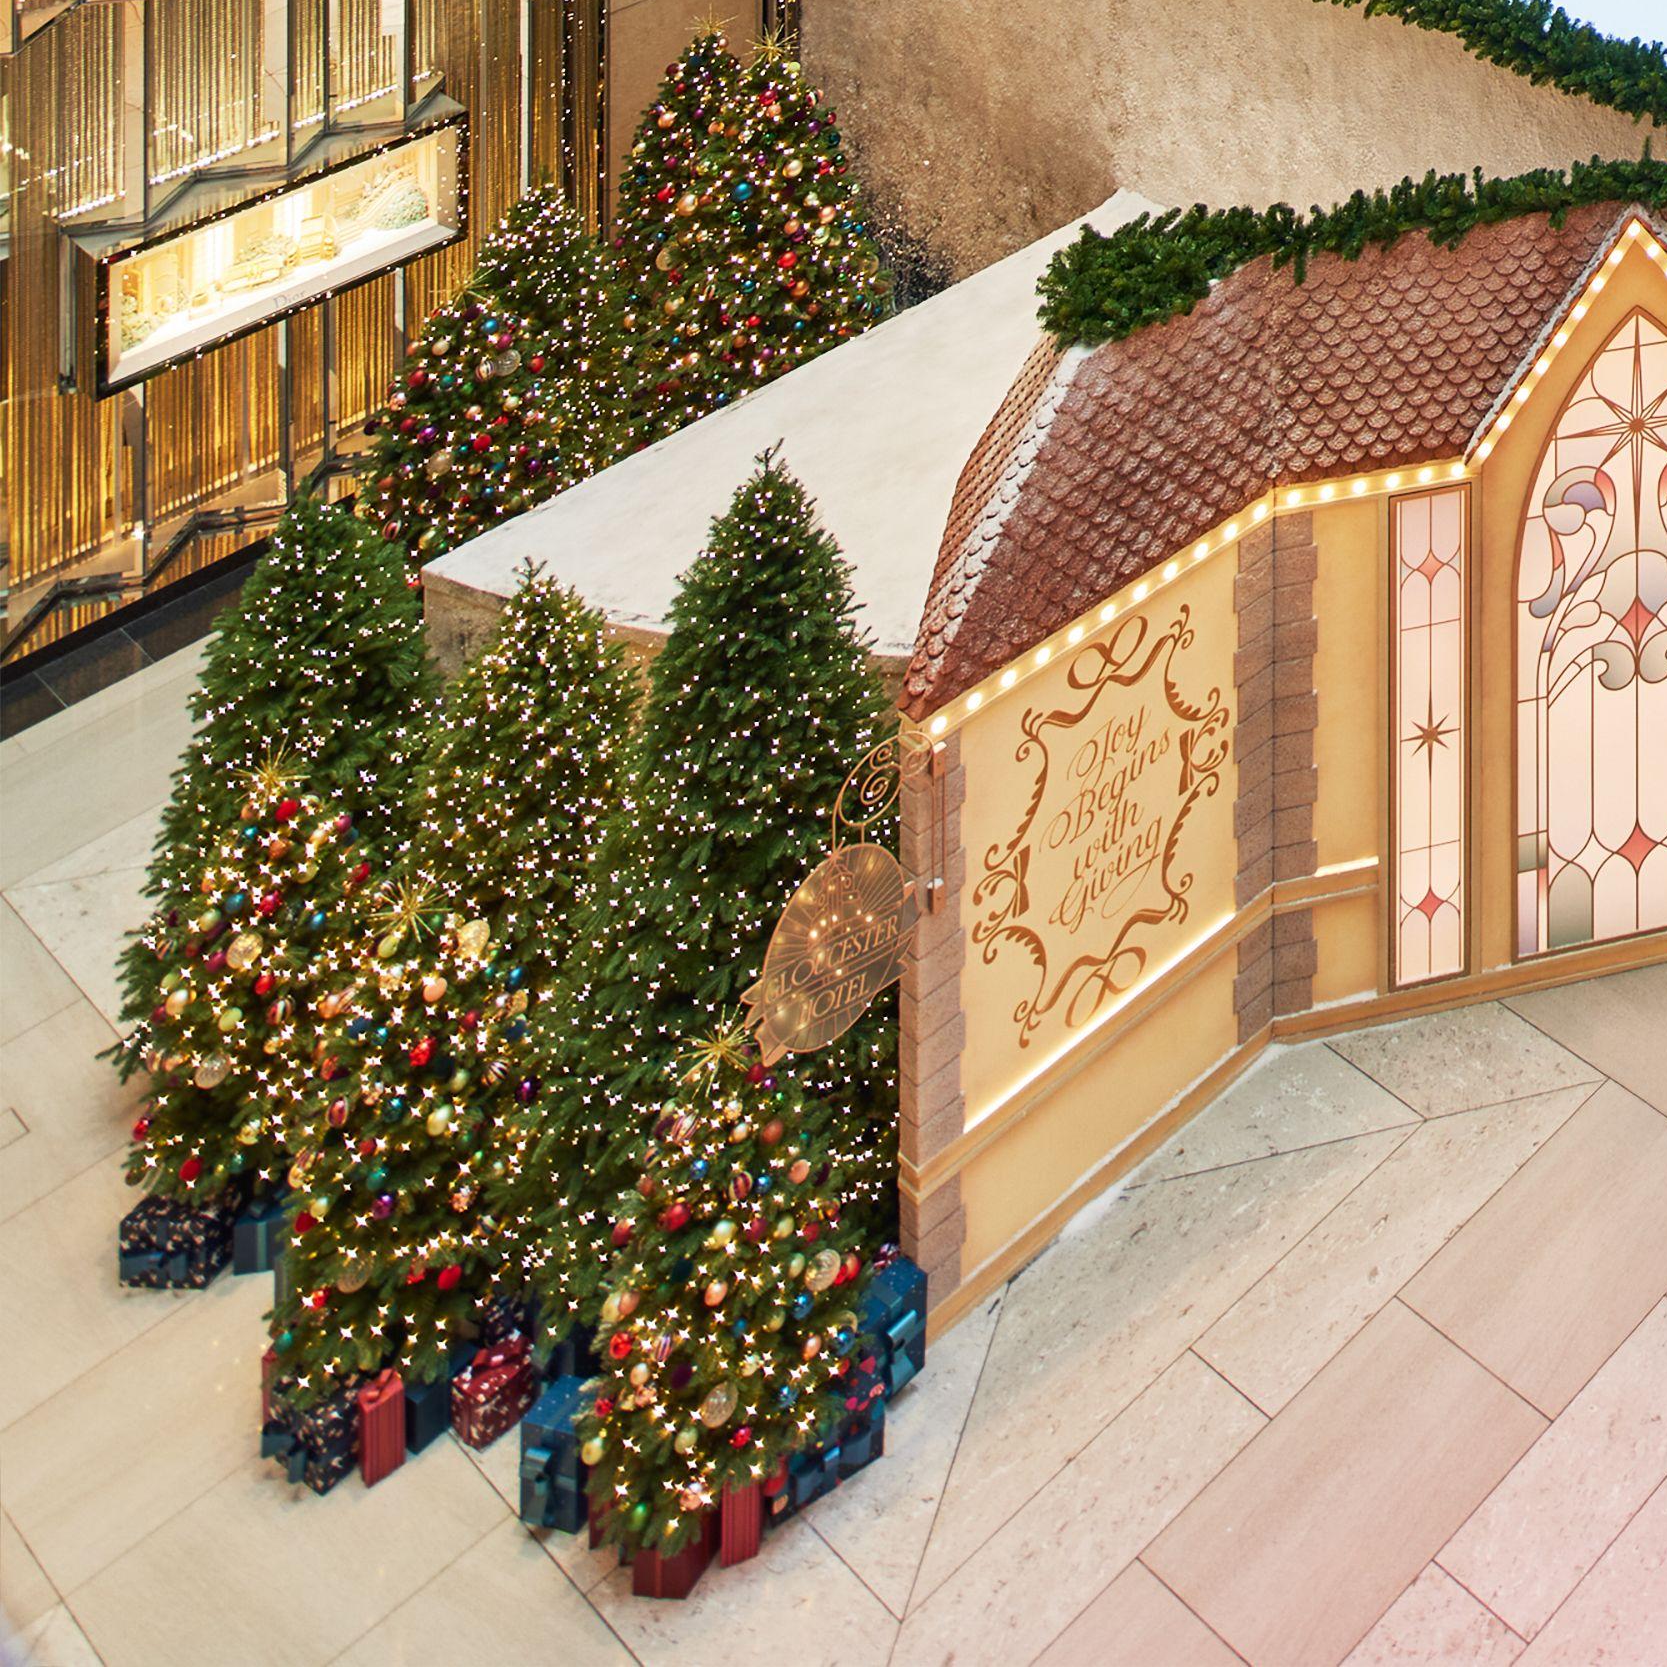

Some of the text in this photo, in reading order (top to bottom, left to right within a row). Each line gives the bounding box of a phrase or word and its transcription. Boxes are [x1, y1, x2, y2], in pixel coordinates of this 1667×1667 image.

[1039, 727, 1170, 852] Begins
[1067, 705, 1152, 791] Joy
[1048, 815, 1163, 934] Giving
[1074, 799, 1143, 880] with
